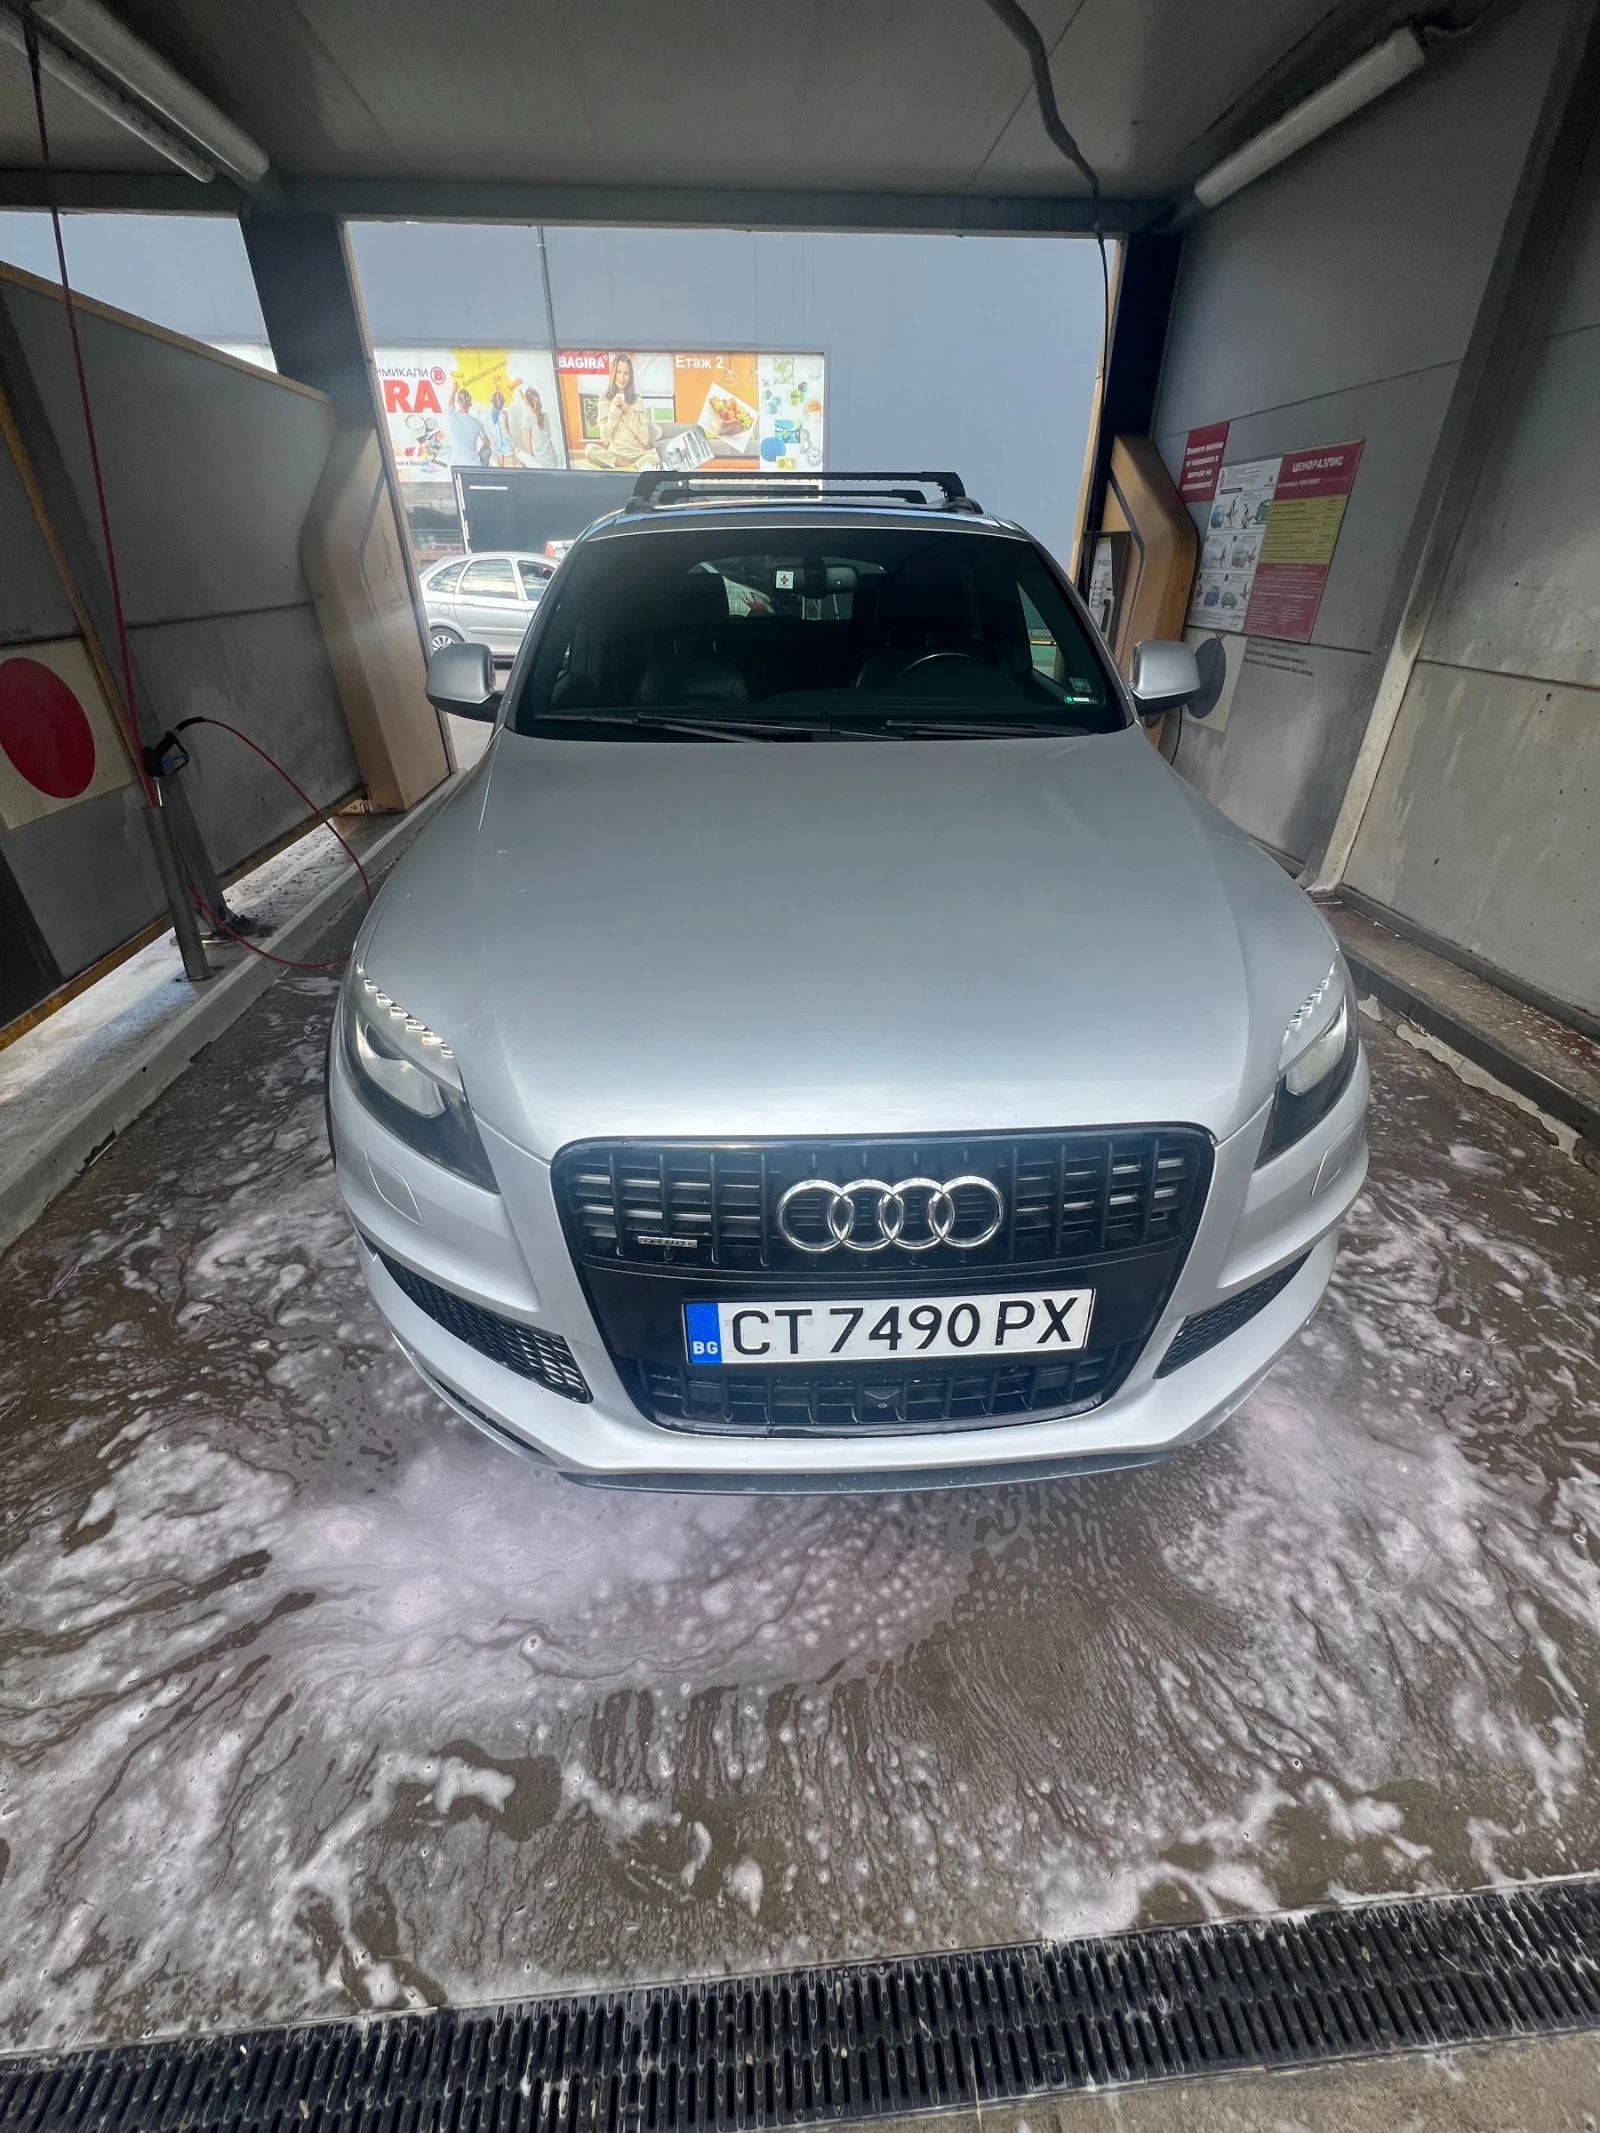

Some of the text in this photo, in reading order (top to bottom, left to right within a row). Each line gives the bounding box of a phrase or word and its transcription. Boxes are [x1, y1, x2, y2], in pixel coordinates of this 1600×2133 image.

[558, 355, 606, 369] BAGIRA
[675, 355, 724, 369] Етаж 2
[383, 379, 442, 414] RA
[1292, 456, 1344, 473] ЦЕНОРАЗПИС
[732, 1297, 1079, 1355] CT 7490 PX
[693, 1340, 719, 1355] BG
